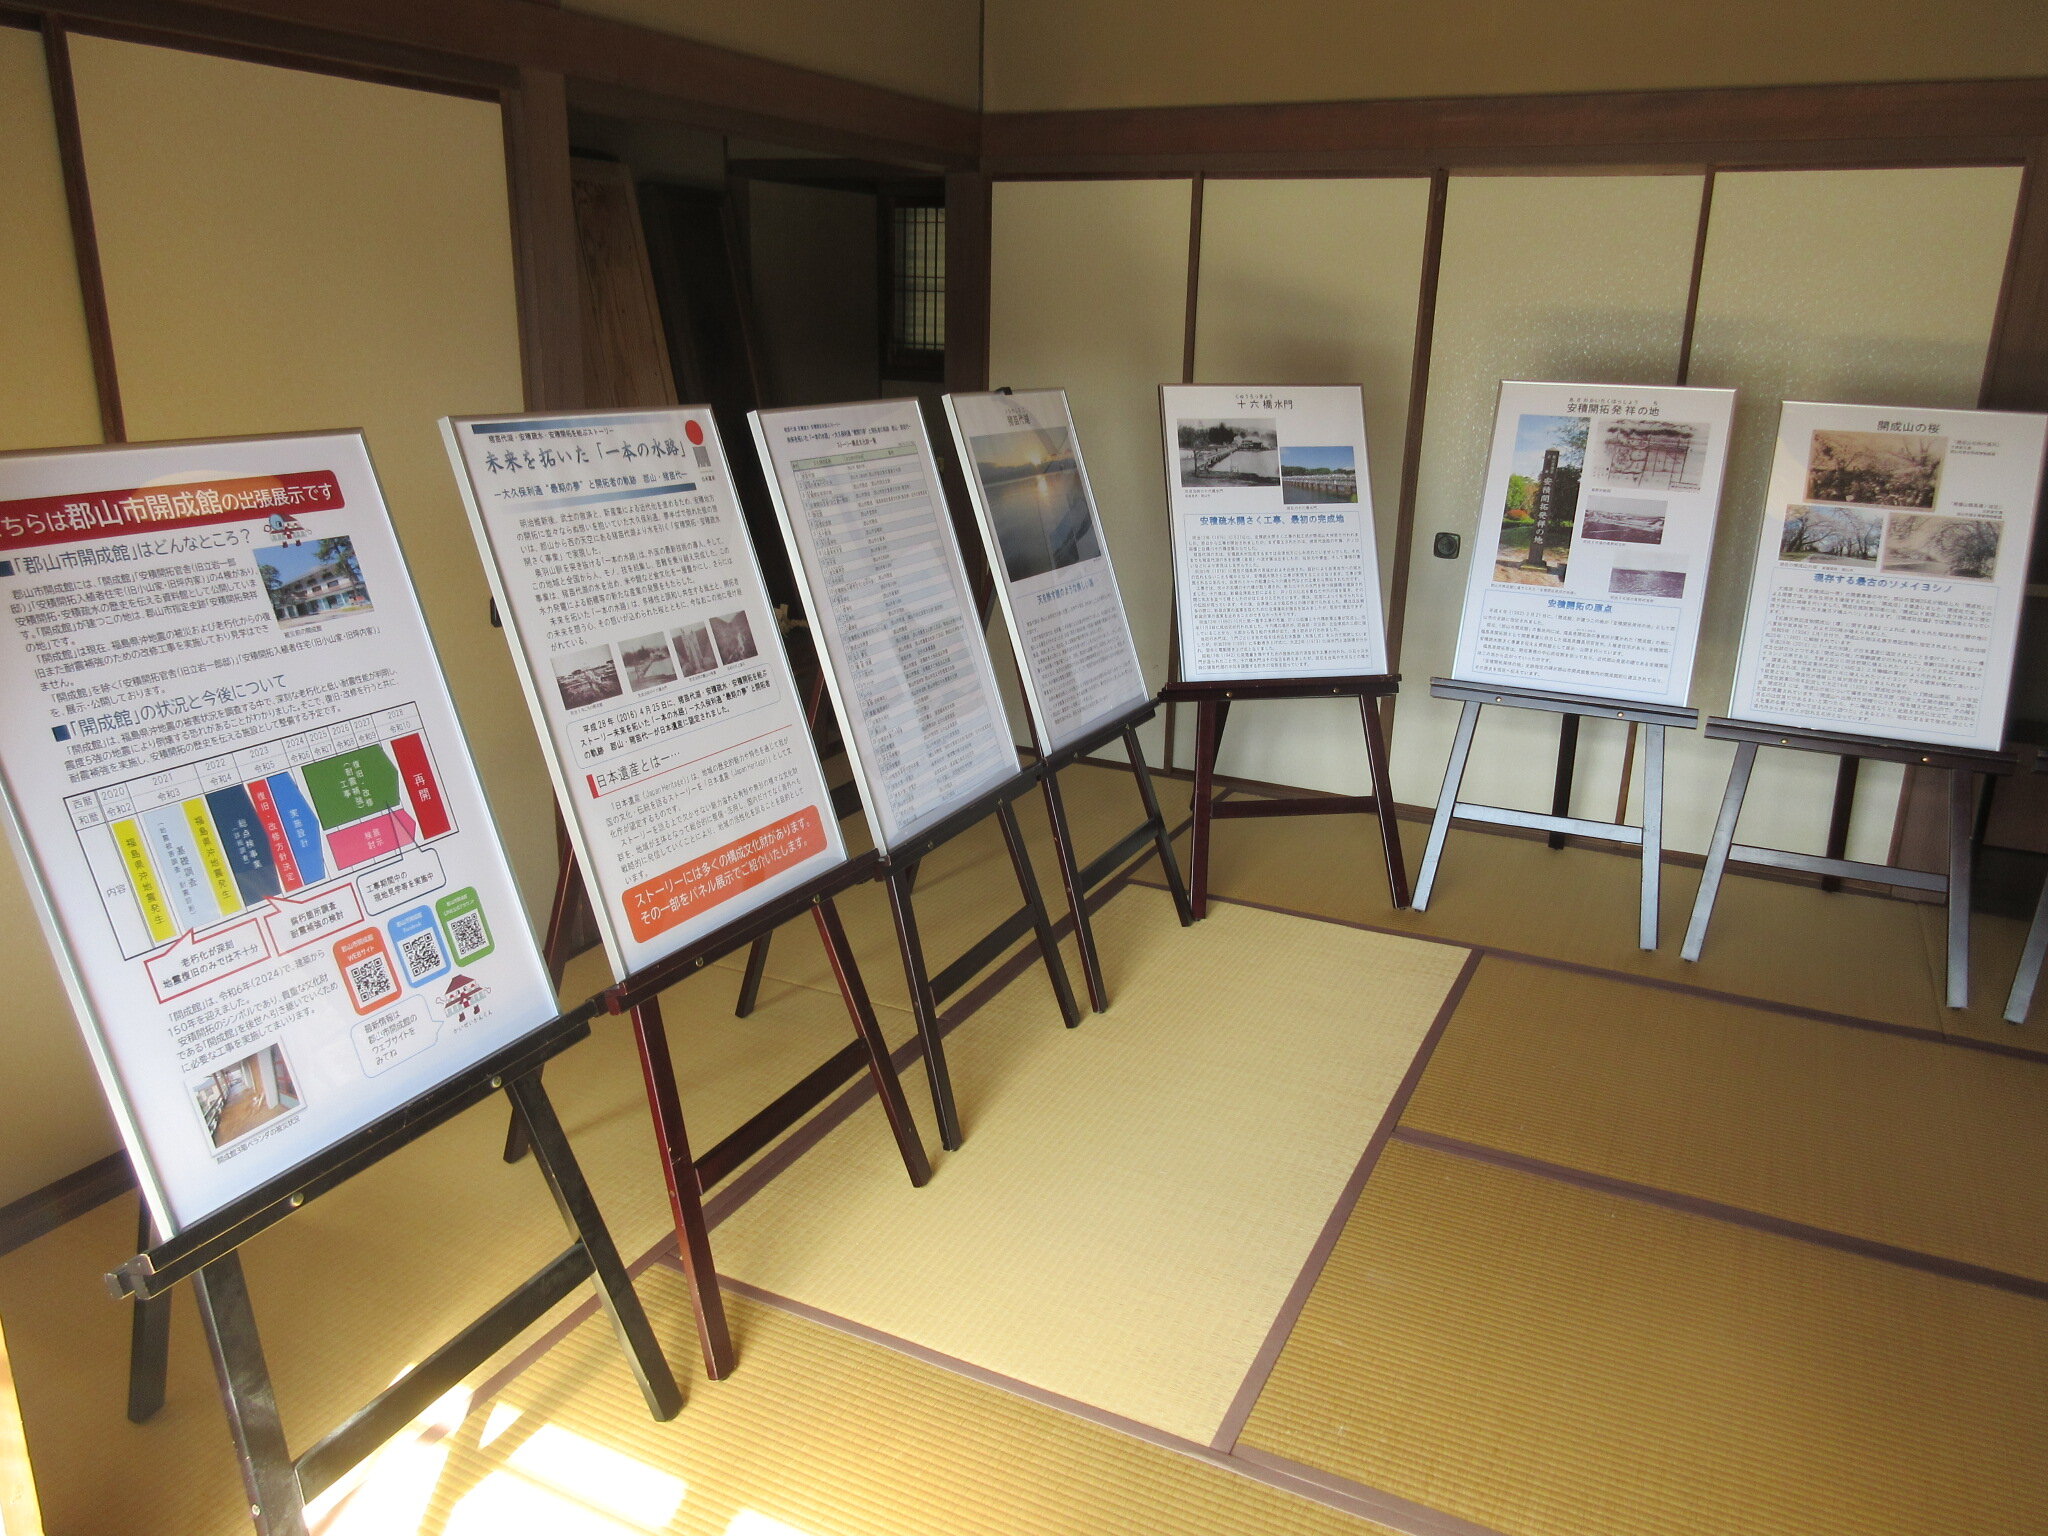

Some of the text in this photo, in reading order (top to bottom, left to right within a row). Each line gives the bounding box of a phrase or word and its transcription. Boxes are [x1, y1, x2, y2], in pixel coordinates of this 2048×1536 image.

[1236, 400, 1292, 409] 十六橋水門
[1566, 403, 1660, 416] 安積開拓発祥の地
[1876, 420, 1940, 433] 開成山の桜
[0, 482, 336, 538] ちらは郡山市開成館の出張展示です
[1547, 599, 1612, 613] 安積開拓の原点
[386, 708, 403, 719] 2028
[331, 724, 350, 735] 2026
[353, 718, 371, 728] 2027
[389, 720, 411, 733] 令和10
[285, 736, 304, 748] 2024
[308, 730, 328, 741] 2025
[357, 730, 376, 742] 令和9
[313, 743, 333, 755] 令和7
[335, 736, 355, 749] 令和8
[249, 746, 269, 758] 2023
[289, 749, 310, 762] 令和6
[204, 758, 226, 771] 2022
[253, 760, 275, 773] 令和5
[151, 773, 173, 785] 2021
[208, 772, 232, 786] 令和4
[100, 786, 126, 800] 2020
[340, 780, 352, 799] 工事
[412, 772, 431, 802] 再開
[156, 787, 181, 802] 令和3
[105, 802, 132, 817] 令和2
[289, 807, 310, 848] 実施設計
[633, 814, 810, 909] ストーリーには多くの構成文化財があります。
[365, 870, 408, 893] 工事期間中の
[639, 832, 808, 927] その一部をパネル展示でご紹介いたします。
[105, 882, 127, 898] 内容
[364, 1009, 400, 1034] 最新情報は
[375, 1048, 397, 1065] みてね
